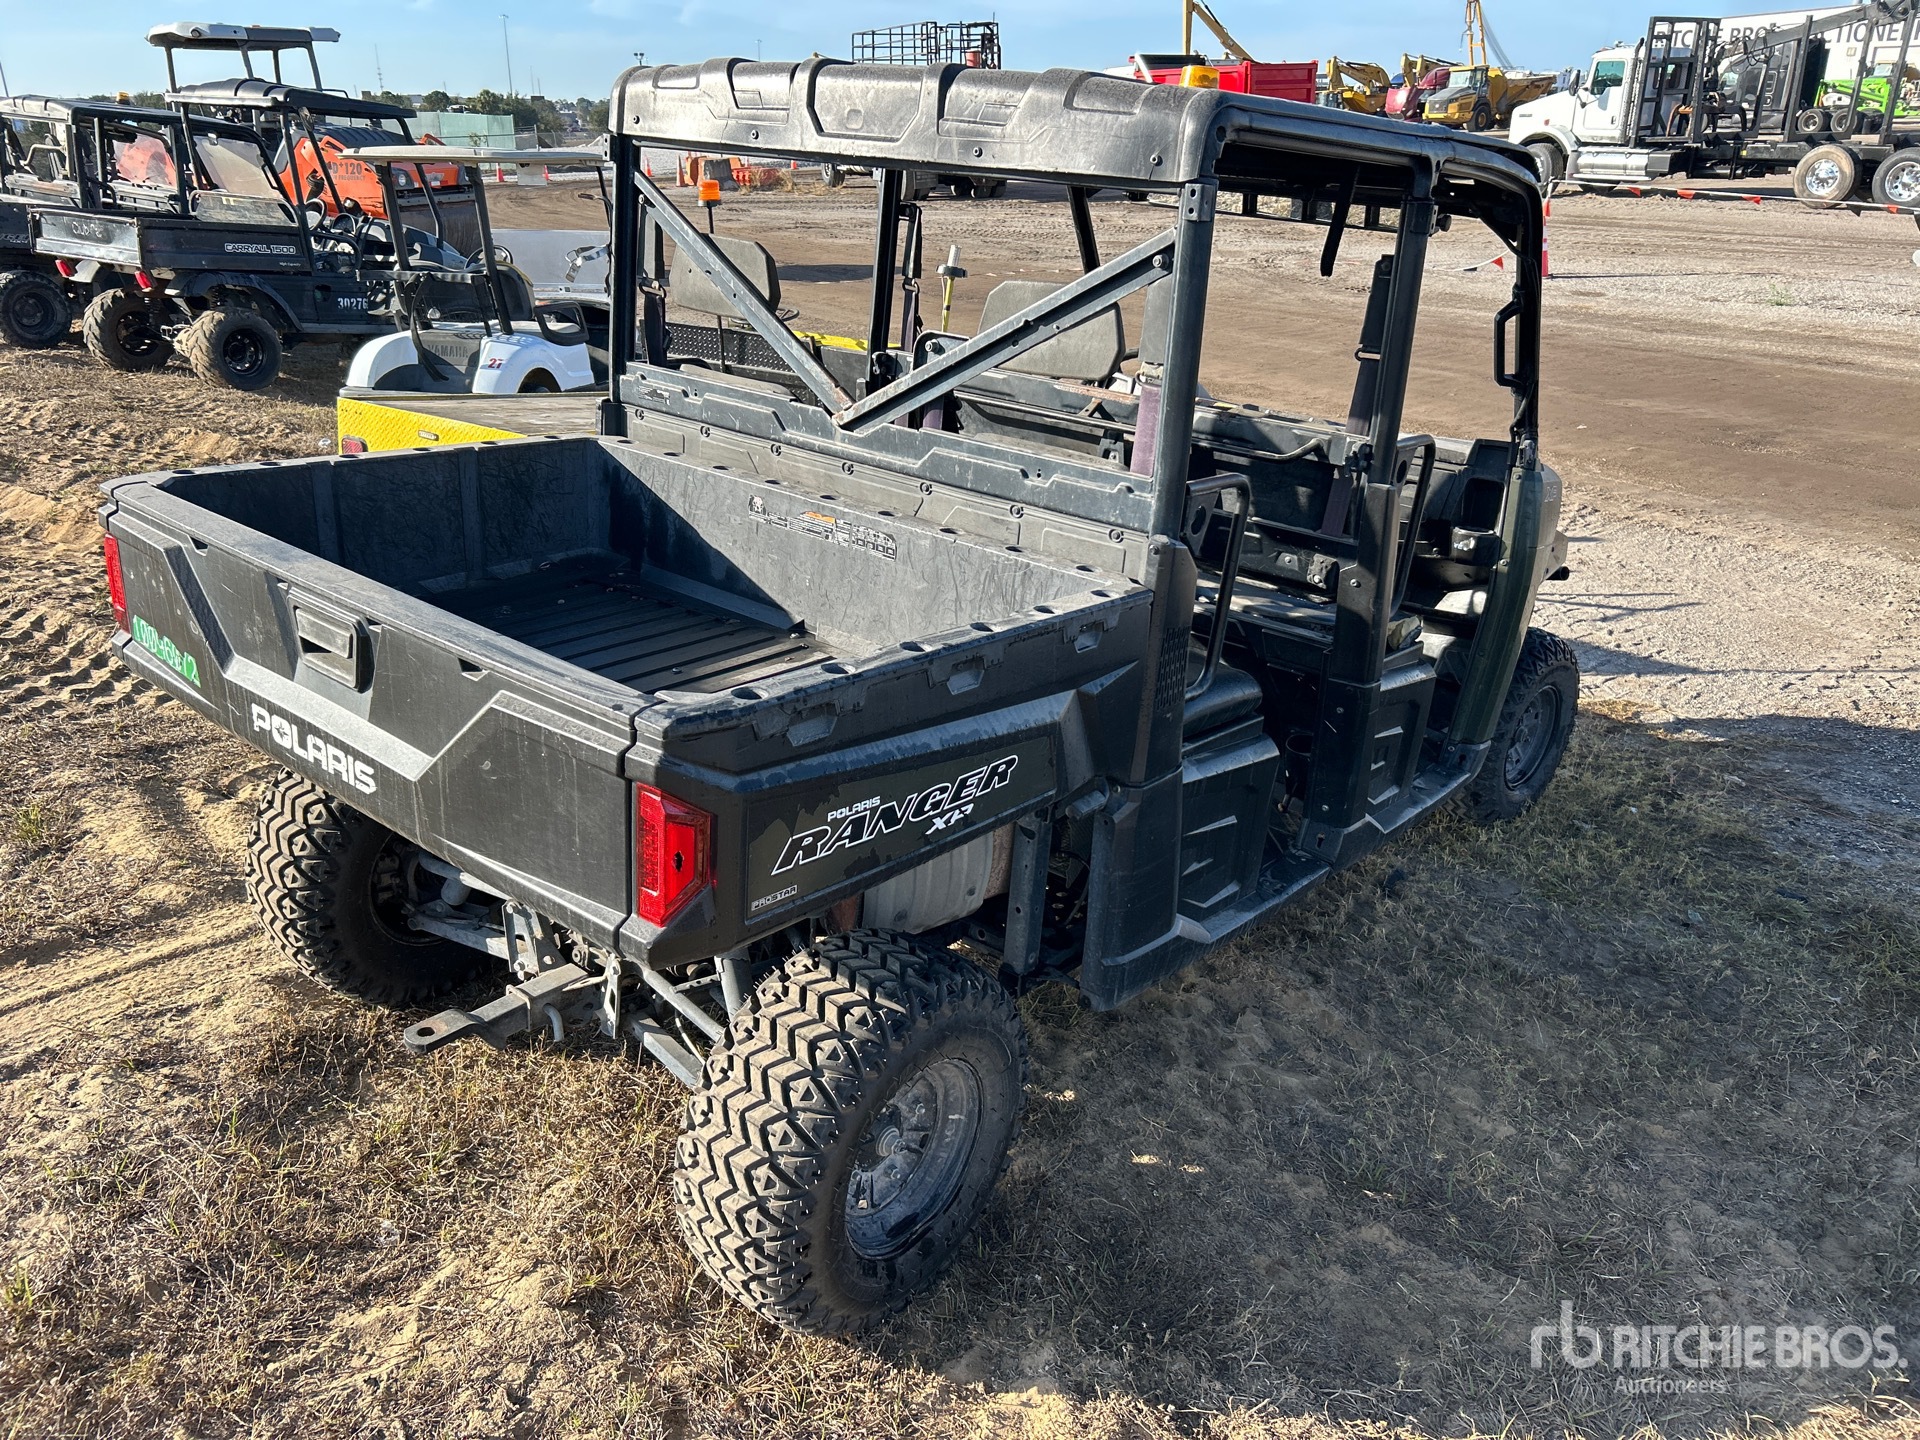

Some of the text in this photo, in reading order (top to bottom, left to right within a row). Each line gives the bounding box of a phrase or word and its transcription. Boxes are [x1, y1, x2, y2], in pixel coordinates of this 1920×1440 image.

[225, 243, 296, 255] CARRYALL 1500
[427, 344, 469, 358] YAMAHA
[251, 702, 378, 795] POLARIS
[771, 754, 1019, 876] RANGER
[827, 796, 881, 823] POLARIS
[925, 803, 974, 835] XP
[751, 884, 798, 911] PROSTAR
